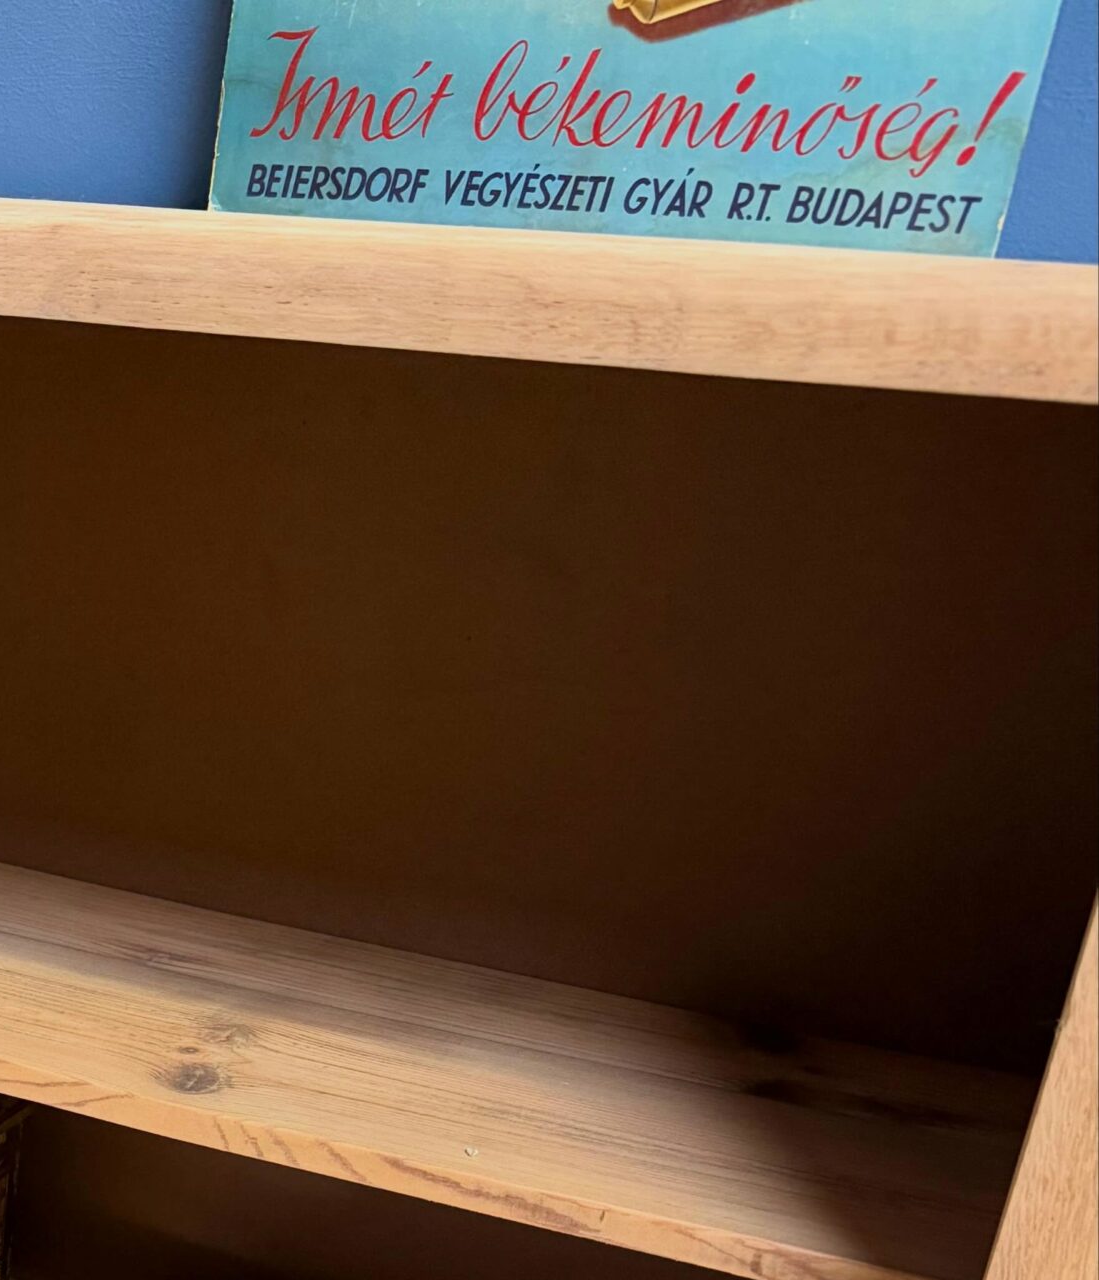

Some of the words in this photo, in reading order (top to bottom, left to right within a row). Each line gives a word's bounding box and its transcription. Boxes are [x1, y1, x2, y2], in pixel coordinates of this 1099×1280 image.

[249, 25, 455, 142] Ismét
[473, 39, 1027, 178] békeminőség!
[246, 163, 429, 203] BEIERSDORF
[444, 163, 615, 213] VEGYÉSZETI
[623, 167, 713, 218] GYÁR
[727, 183, 781, 222] R.T.
[786, 186, 982, 234] BUDAPEST
